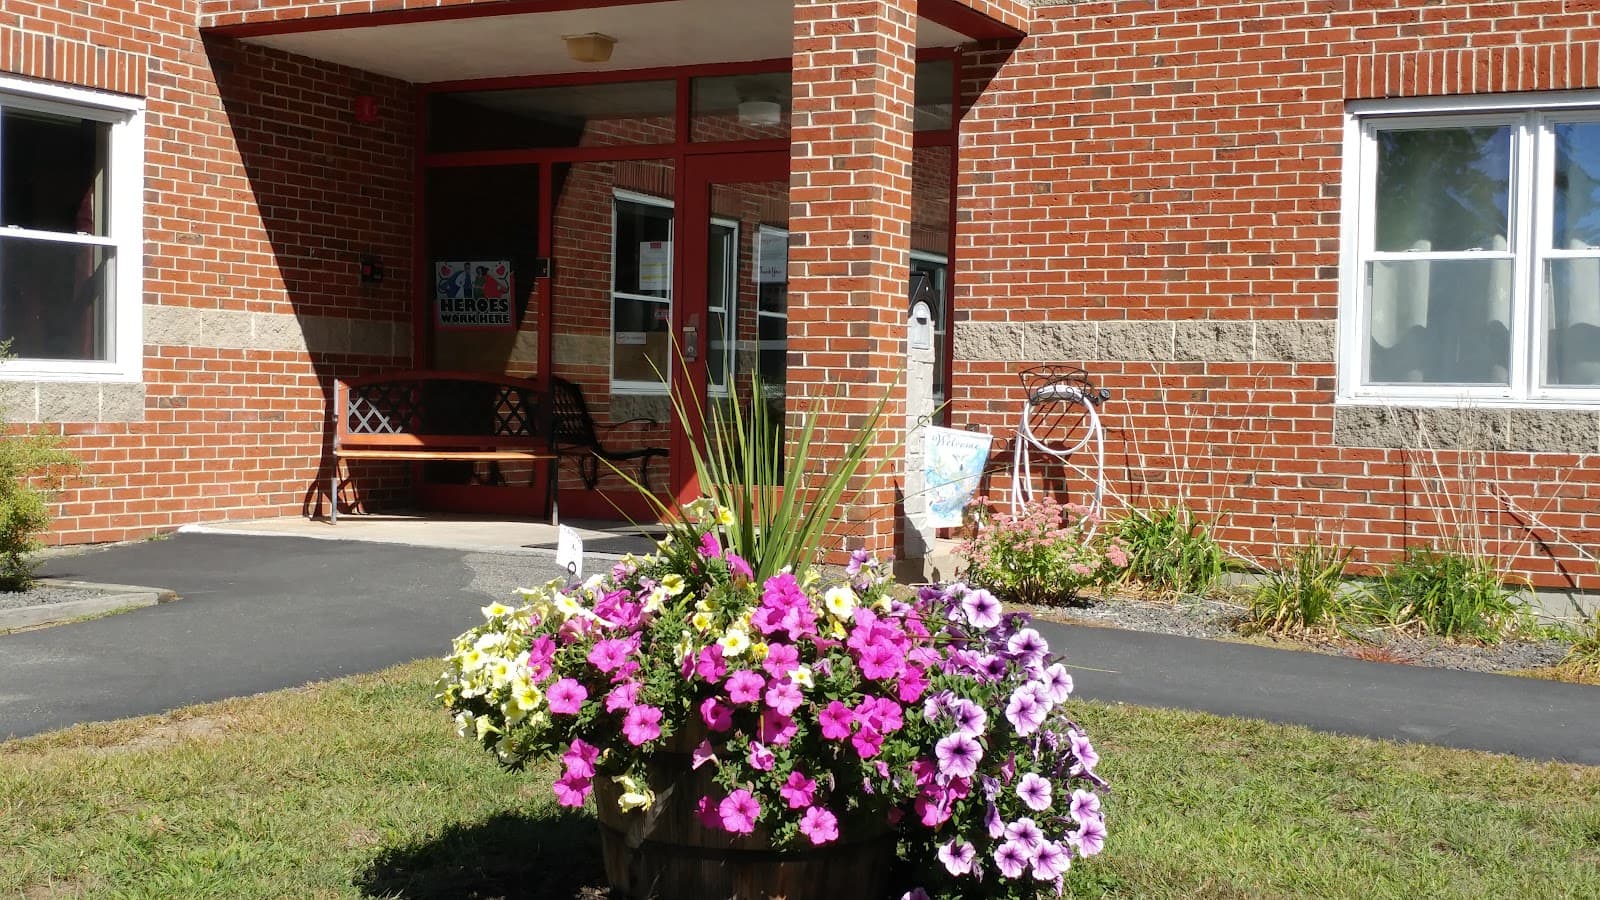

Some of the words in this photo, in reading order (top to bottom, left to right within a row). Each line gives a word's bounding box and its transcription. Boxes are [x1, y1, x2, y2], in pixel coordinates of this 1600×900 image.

[440, 298, 509, 312] HEROES
[441, 313, 477, 323] WORK
[479, 314, 510, 324] HERE
